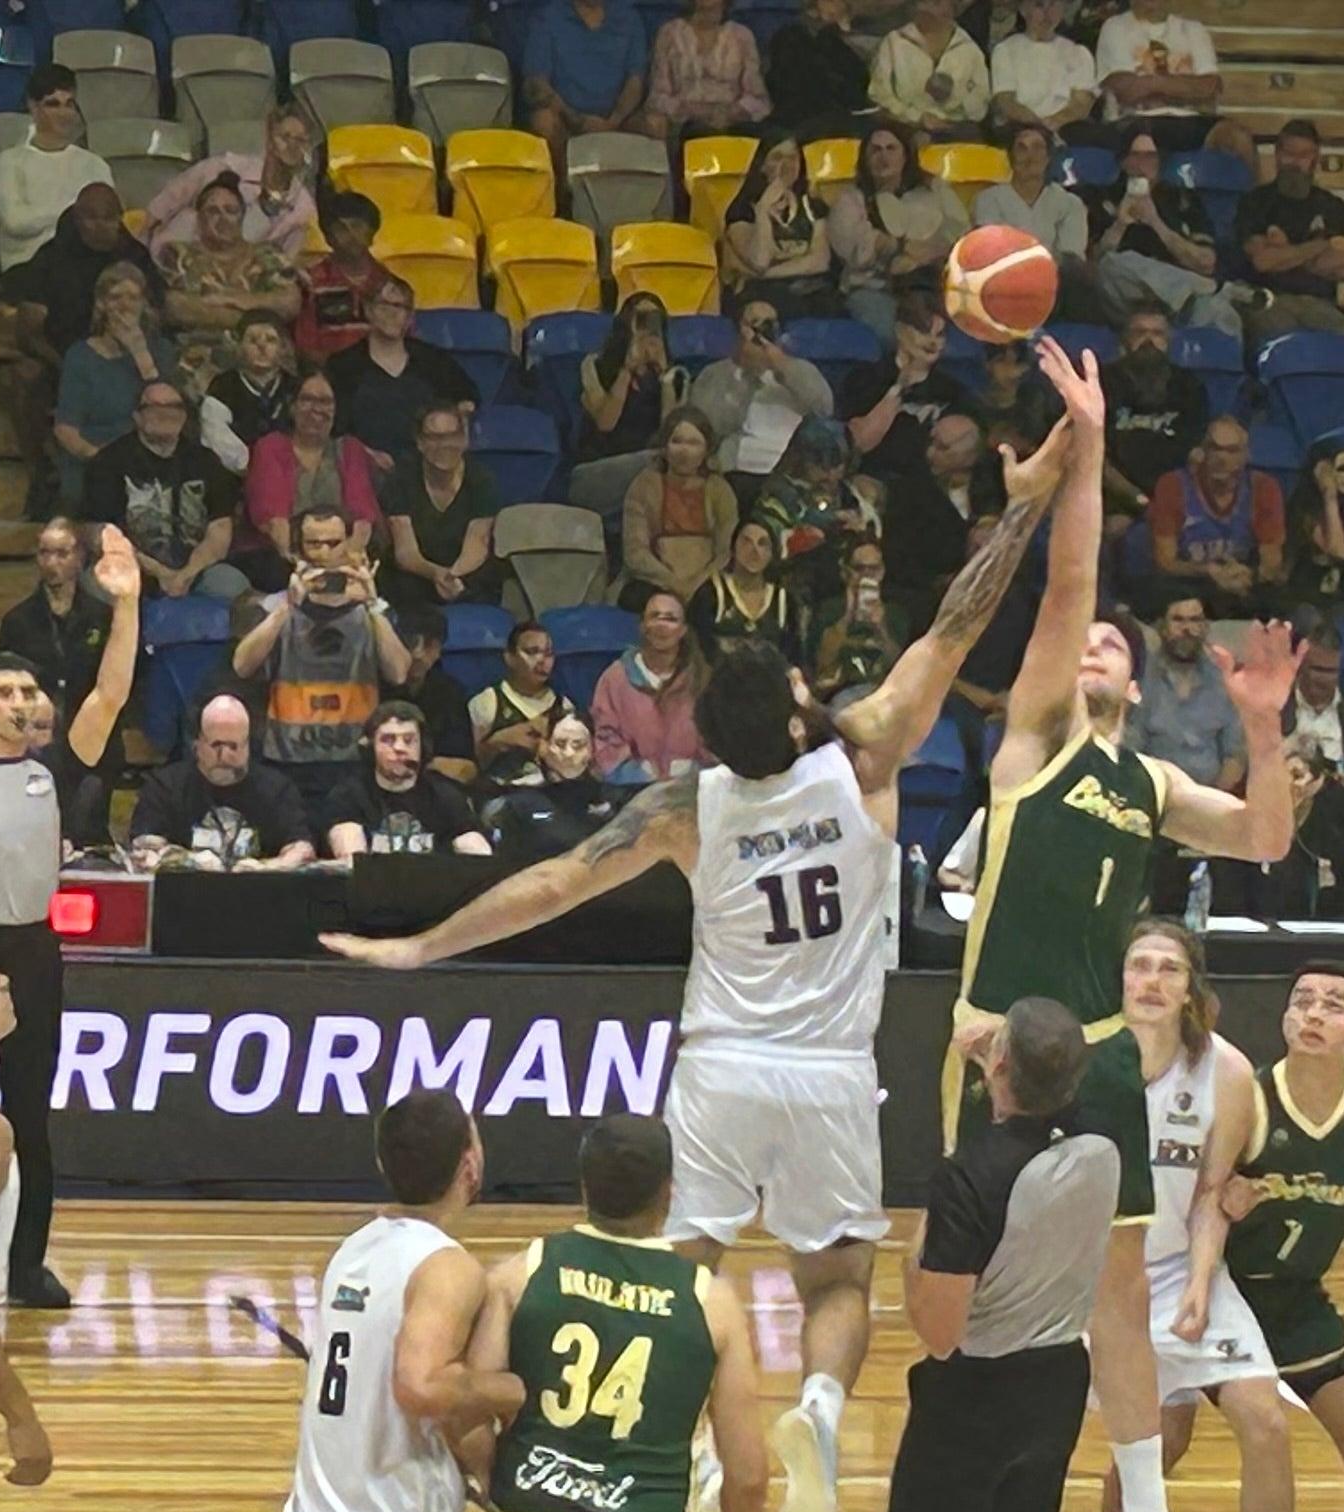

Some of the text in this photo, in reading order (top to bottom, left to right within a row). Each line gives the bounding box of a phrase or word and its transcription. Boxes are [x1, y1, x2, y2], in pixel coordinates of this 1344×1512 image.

[755, 864, 844, 945] 16
[1095, 856, 1115, 907] 1
[318, 1331, 351, 1416] 6
[540, 1322, 653, 1440] 34
